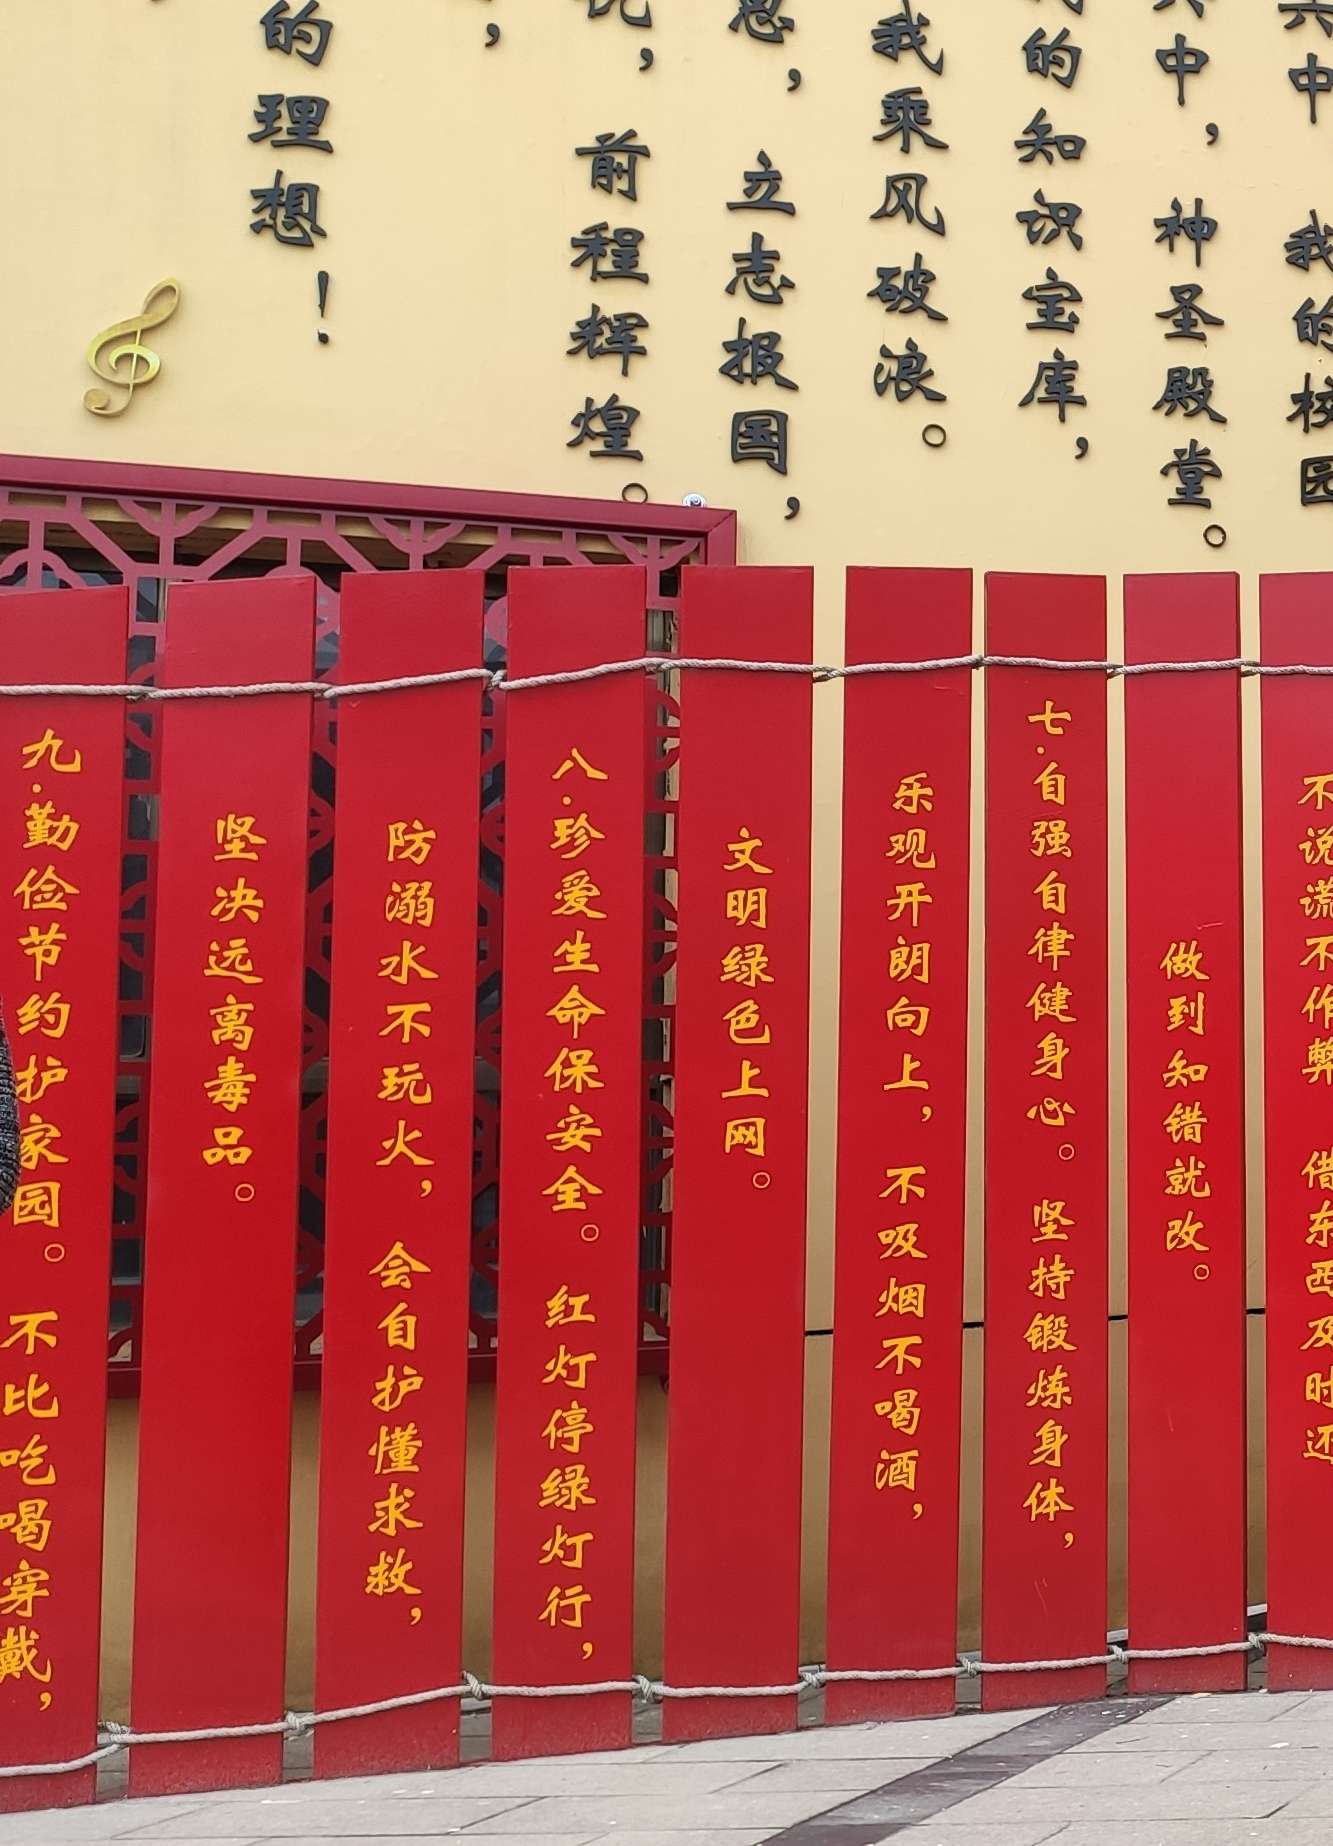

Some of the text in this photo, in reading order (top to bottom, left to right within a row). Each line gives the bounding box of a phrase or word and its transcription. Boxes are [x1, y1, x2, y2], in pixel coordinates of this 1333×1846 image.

[867, 0, 948, 448] 我乘风破浪。
[1015, 0, 1088, 459] 的知识宝库，
[1152, 0, 1227, 547] 中，神圣殿堂。
[203, 814, 266, 1201] 坚决远离毒品。
[720, 828, 774, 1188] 文明绿色上网。
[1160, 941, 1210, 1279] 做到知错就改。
